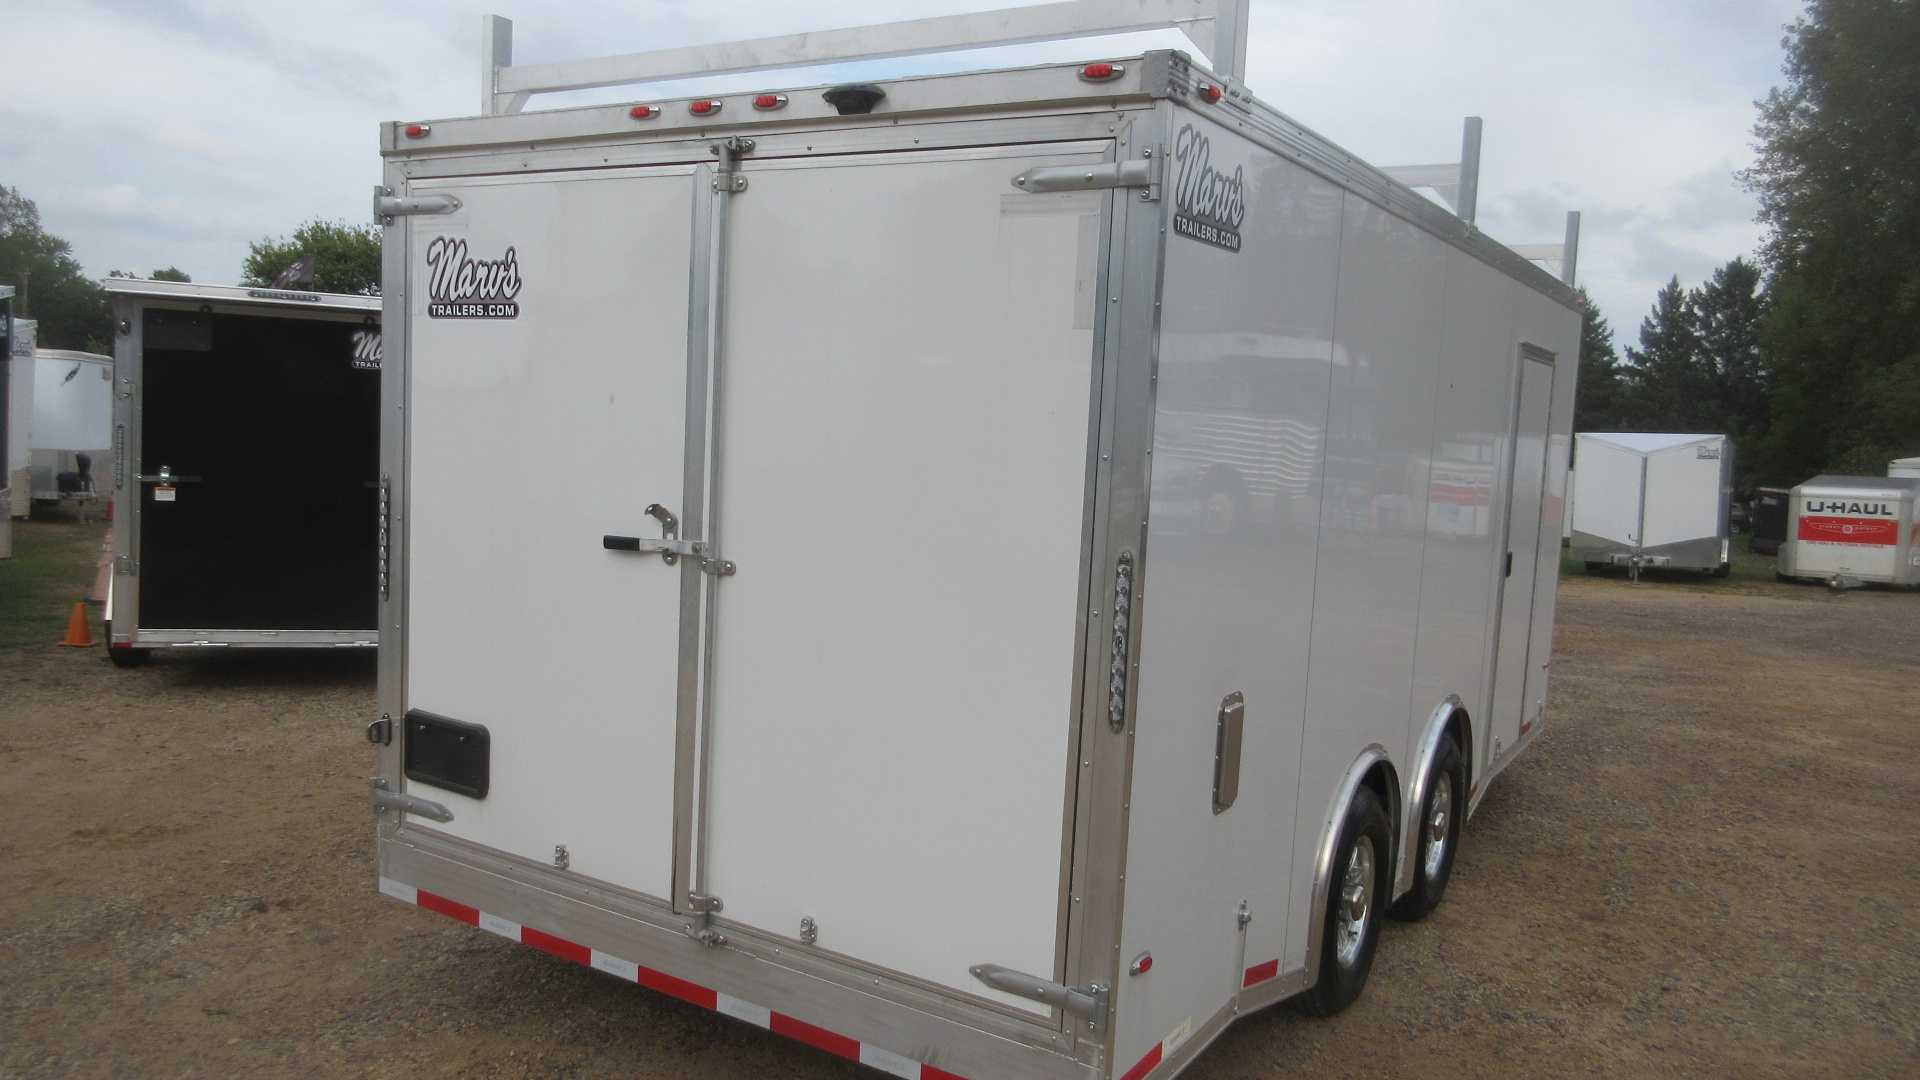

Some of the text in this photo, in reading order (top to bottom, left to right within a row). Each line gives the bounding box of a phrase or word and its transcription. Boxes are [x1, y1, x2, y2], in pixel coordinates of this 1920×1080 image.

[1176, 124, 1244, 228] Marv's
[1176, 215, 1239, 249] TRAILERS.COM
[427, 237, 521, 302] Marv's
[431, 304, 515, 316] TRAILERS.COM
[1806, 501, 1893, 516] U-HAUL
